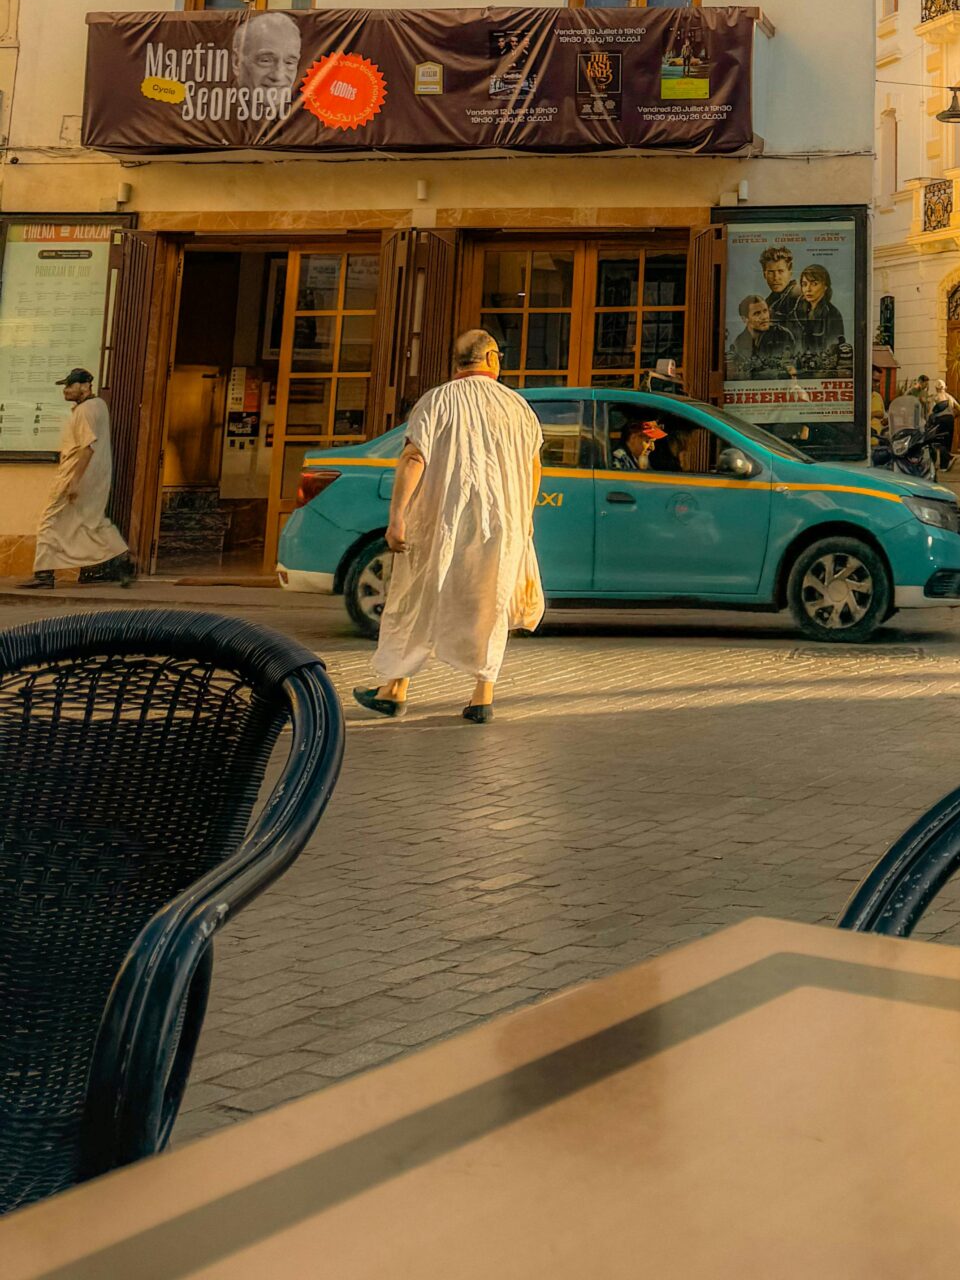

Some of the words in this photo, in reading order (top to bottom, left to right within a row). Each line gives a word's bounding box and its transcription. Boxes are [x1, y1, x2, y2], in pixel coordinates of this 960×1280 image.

[145, 42, 228, 83] Martin
[152, 83, 176, 95] Cycle
[182, 81, 292, 121] Scorsese
[821, 381, 853, 390] THE
